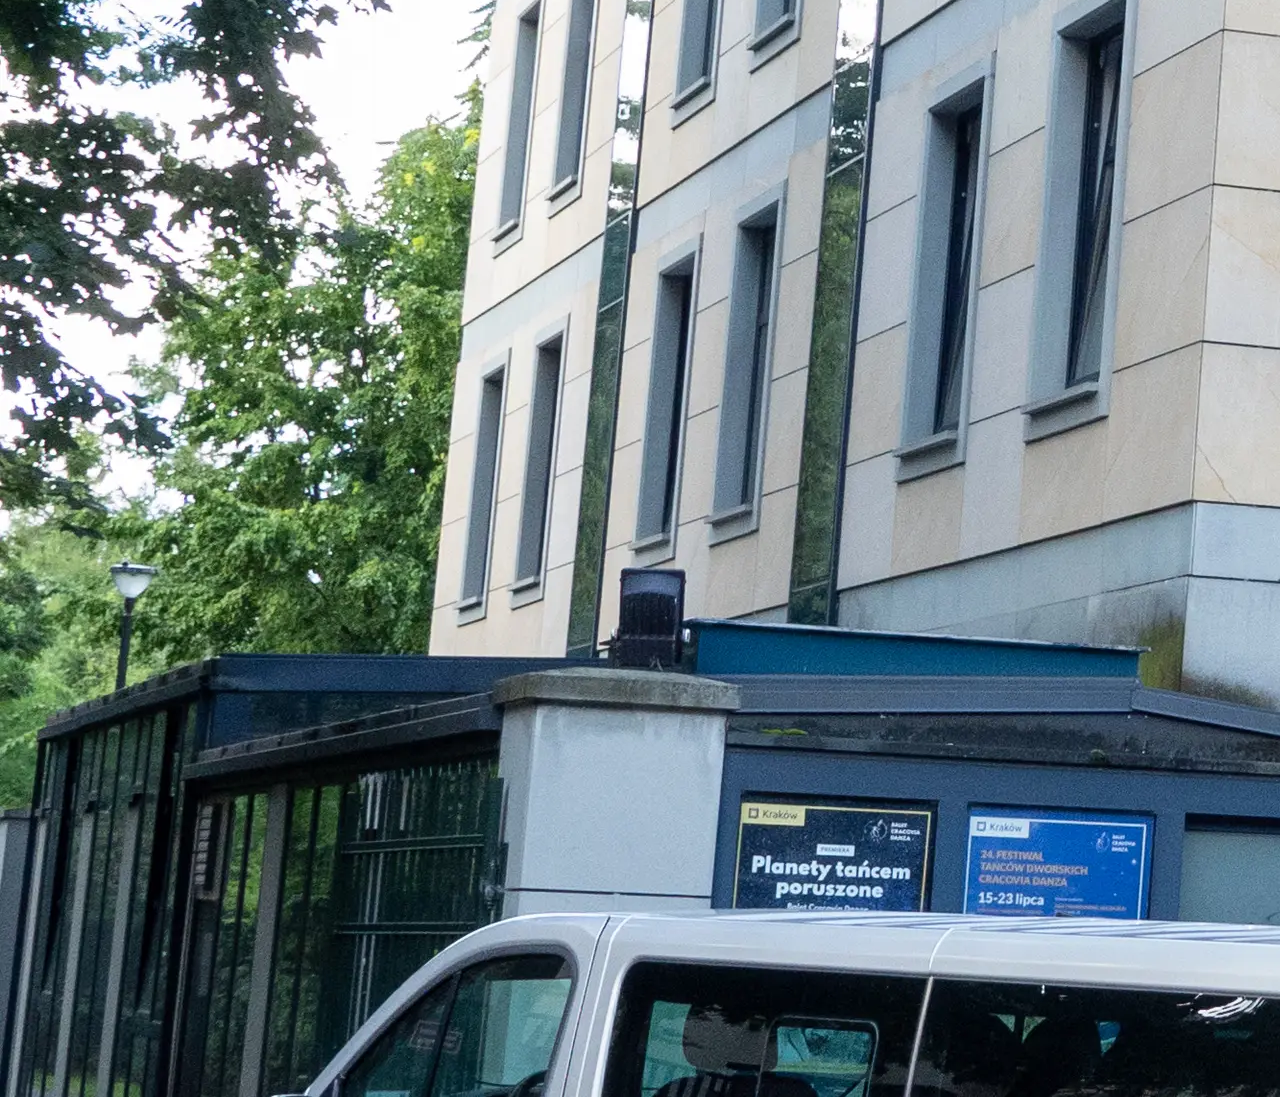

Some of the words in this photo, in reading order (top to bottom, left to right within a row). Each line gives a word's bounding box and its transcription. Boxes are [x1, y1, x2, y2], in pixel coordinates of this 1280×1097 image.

[761, 809, 799, 821] Kraków
[989, 822, 1023, 833] Kraków
[996, 850, 1044, 862] FESTIWAL
[751, 855, 832, 881] Planety
[836, 859, 911, 880] tańcem
[1026, 863, 1089, 876] DWORSKICH
[978, 874, 1031, 886] CRACOVIA
[1032, 876, 1068, 887] DANZA
[775, 881, 884, 899] poruszone
[978, 891, 1014, 905] 15-23
[1015, 892, 1045, 907] lipca
